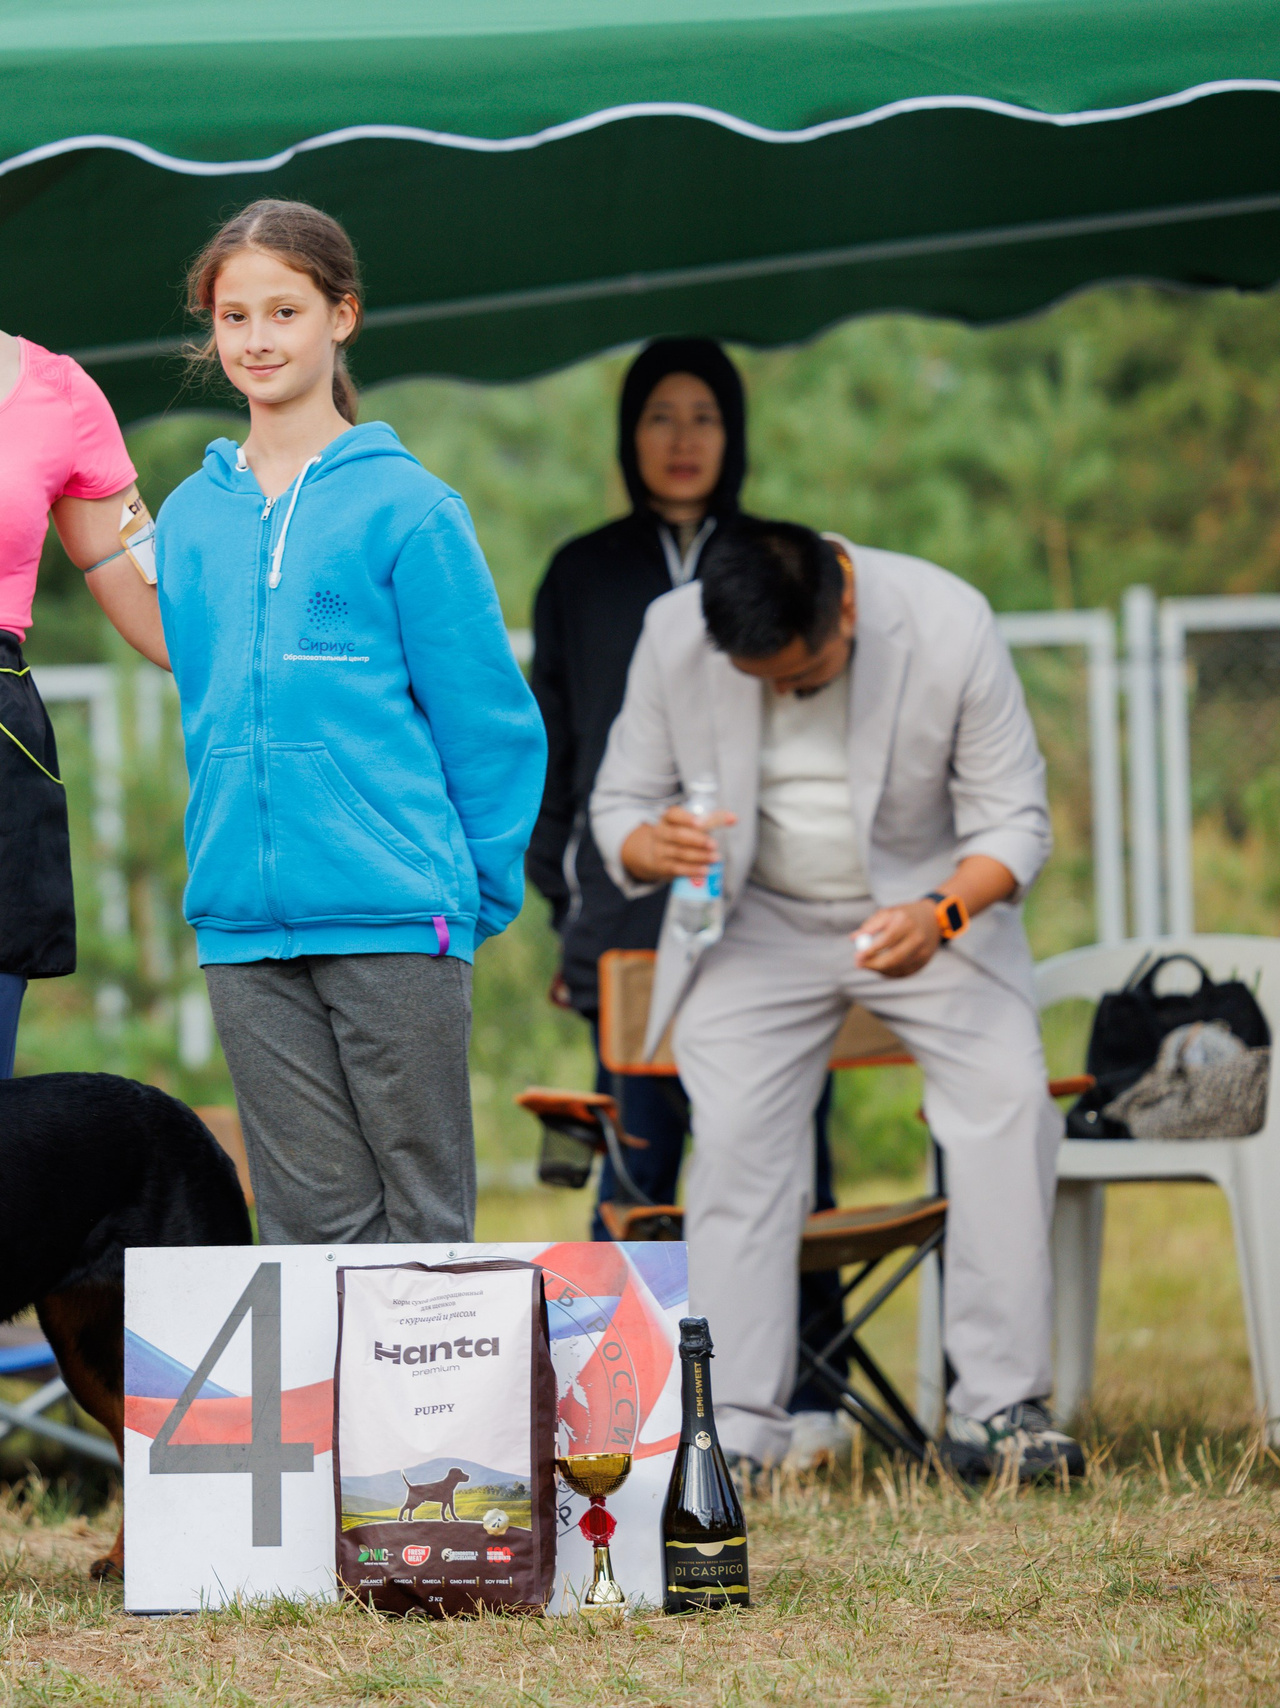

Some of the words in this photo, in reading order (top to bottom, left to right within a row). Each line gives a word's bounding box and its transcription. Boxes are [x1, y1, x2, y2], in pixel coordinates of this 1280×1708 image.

[298, 637, 355, 655] Сириус
[283, 654, 347, 662] Образовательный
[348, 655, 370, 663] центр
[432, 1300, 457, 1310] щенков
[399, 1317, 405, 1325] с
[405, 1312, 442, 1326] курицей
[442, 1313, 449, 1321] и
[449, 1310, 477, 1322] рисом
[374, 1336, 500, 1365] Hanta
[412, 1363, 461, 1378] premium
[586, 1316, 634, 1447] РОССИ
[694, 1361, 705, 1418] SEMI-SWEET
[149, 1262, 314, 1547] 4
[414, 1403, 456, 1416] PUPPY
[407, 1548, 426, 1556] FRESH
[675, 1566, 686, 1577] DI
[691, 1563, 743, 1577] CASPICO
